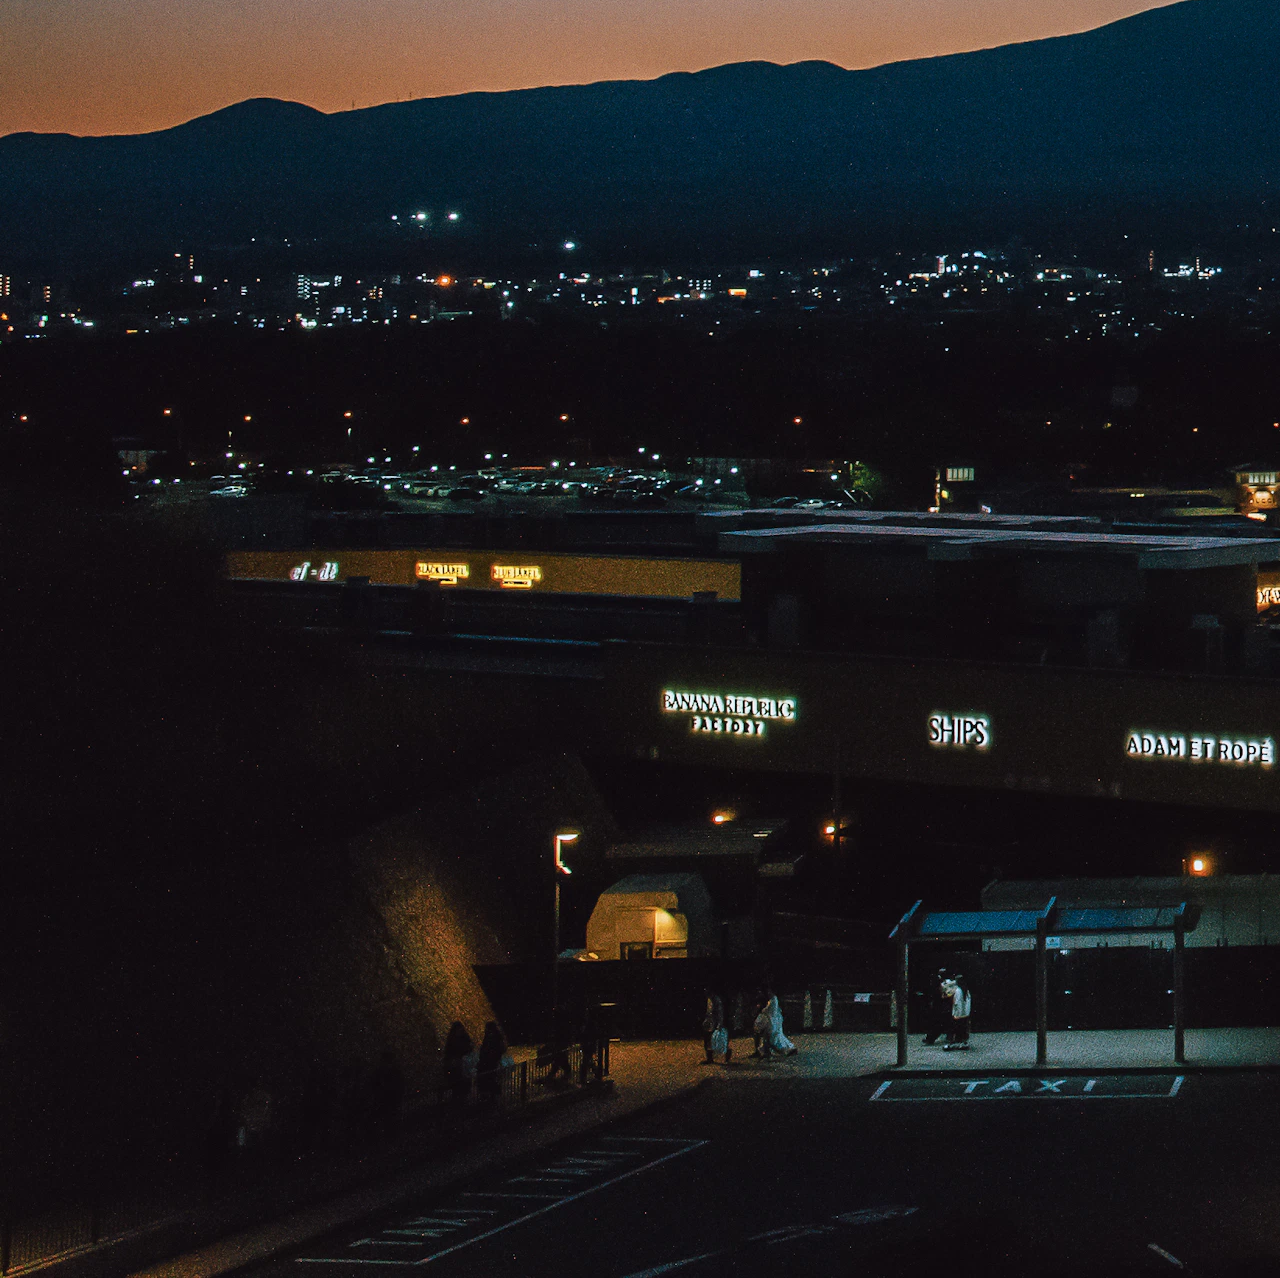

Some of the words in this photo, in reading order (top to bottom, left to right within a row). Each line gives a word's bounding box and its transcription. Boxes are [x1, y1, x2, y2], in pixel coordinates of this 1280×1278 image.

[663, 693, 724, 714] BANANA
[726, 696, 794, 719] REPUBLIC
[691, 717, 764, 735] FACTORY
[928, 717, 986, 744] SHIPS
[1126, 737, 1181, 757] ADAM
[1190, 740, 1212, 758] ET
[1219, 737, 1273, 762] ROPÉ
[958, 1079, 1098, 1094] TAXI
